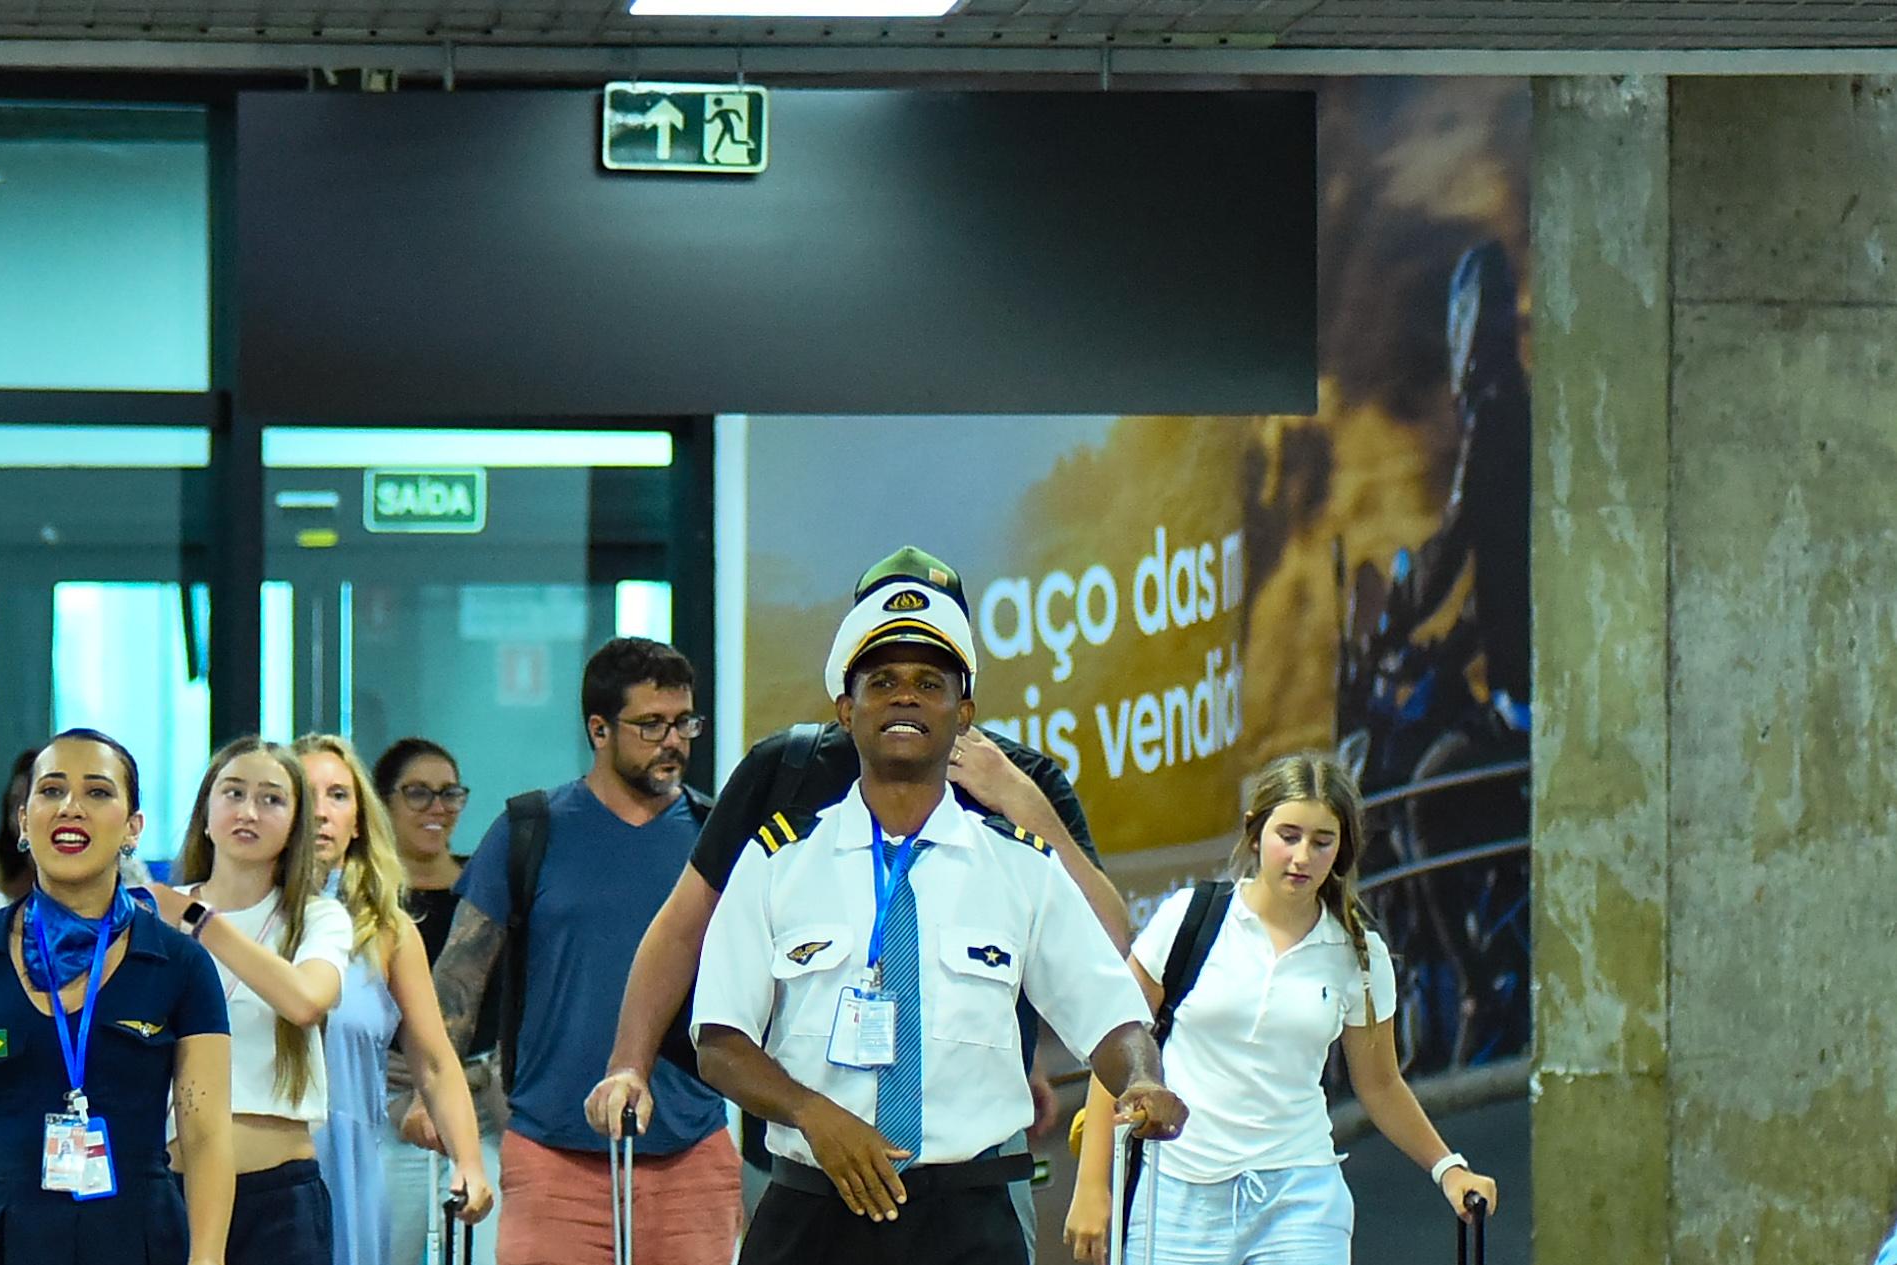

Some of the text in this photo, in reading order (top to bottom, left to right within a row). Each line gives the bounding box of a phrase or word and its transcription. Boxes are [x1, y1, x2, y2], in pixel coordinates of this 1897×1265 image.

[377, 476, 472, 516] SAÍDA
[979, 565, 1118, 682] aço
[1133, 526, 1216, 635] das
